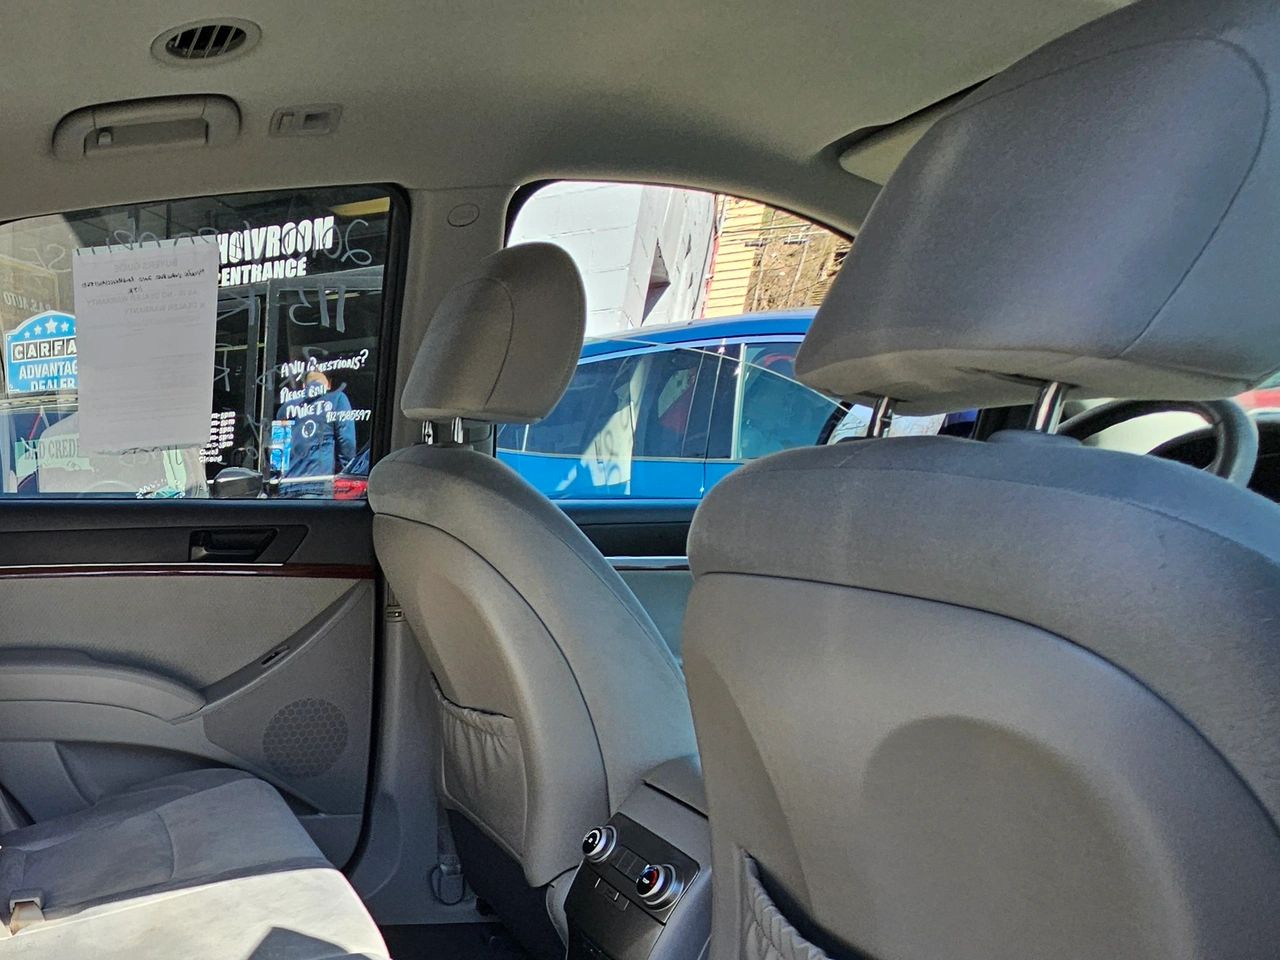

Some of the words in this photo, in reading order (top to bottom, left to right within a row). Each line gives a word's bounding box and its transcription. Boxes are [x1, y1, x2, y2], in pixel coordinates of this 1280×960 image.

[217, 216, 335, 265] HOWROOM
[221, 256, 307, 287] ENTRANCE
[14, 339, 77, 360] CARFA
[19, 360, 78, 380] ADVANTAG
[31, 377, 75, 392] DEALER
[48, 438, 80, 459] CREDI
